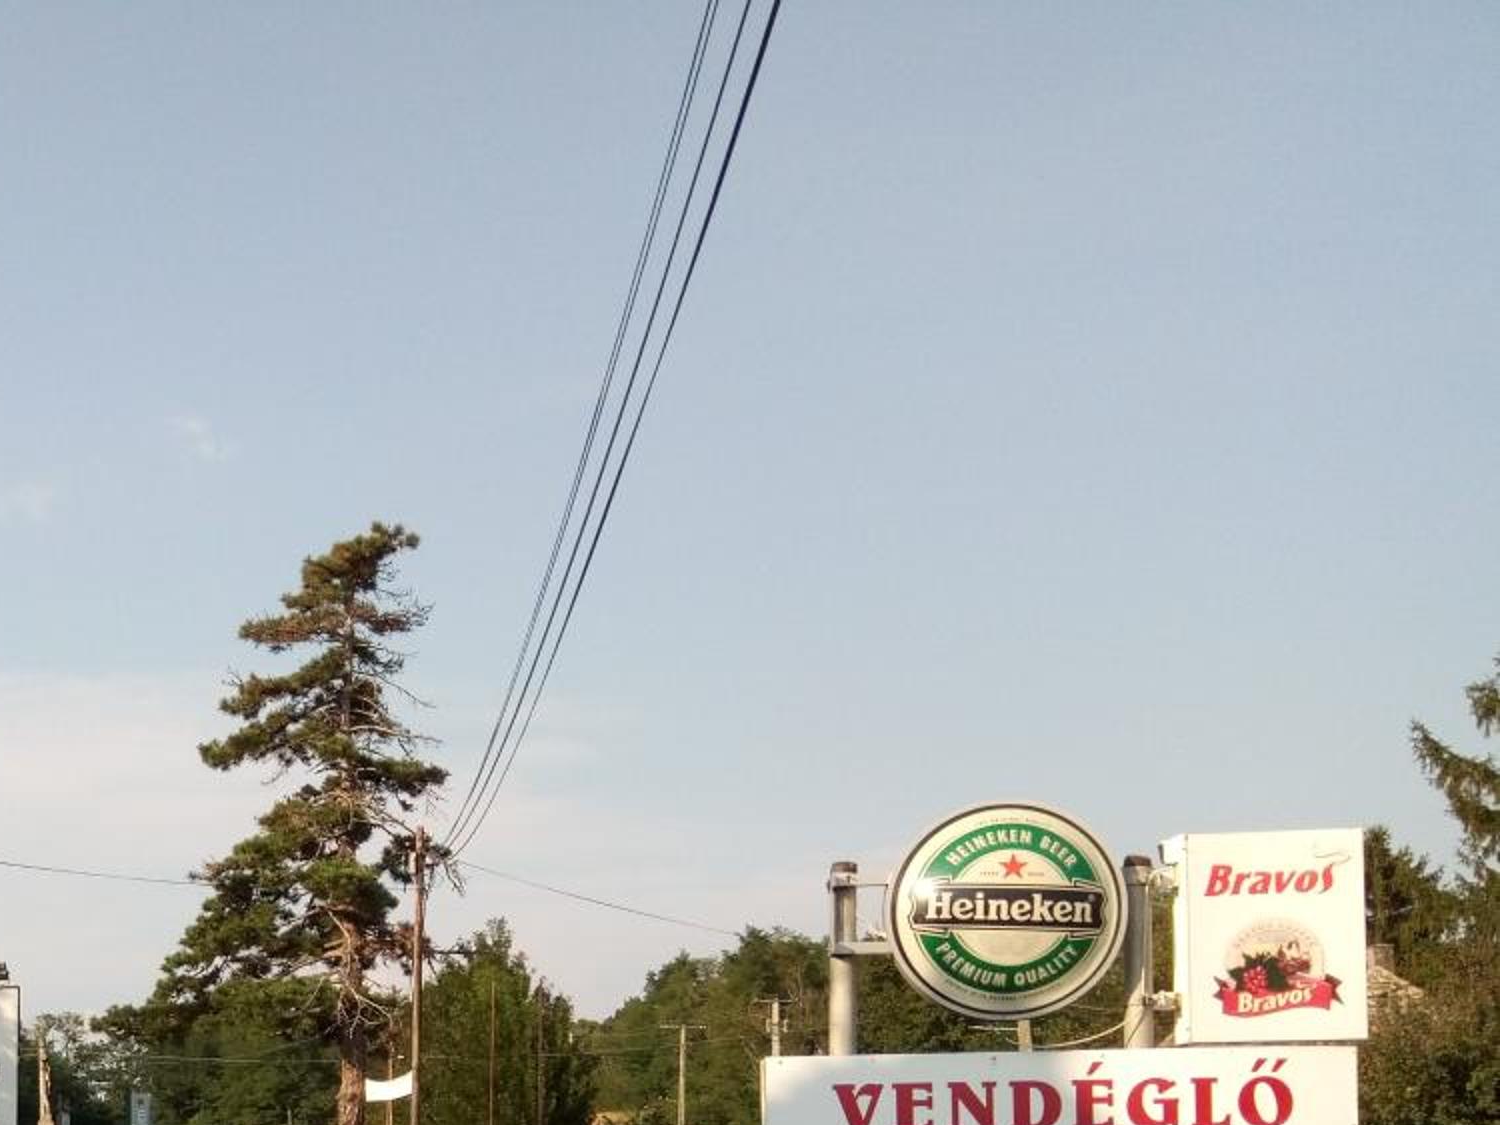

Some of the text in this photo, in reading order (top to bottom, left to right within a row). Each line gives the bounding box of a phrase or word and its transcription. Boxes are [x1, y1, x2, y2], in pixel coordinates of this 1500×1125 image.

[945, 829, 1078, 869] HEINEKEN BEER
[1203, 863, 1334, 896] Bravos
[925, 892, 1093, 923] Heineken
[935, 942, 1078, 987] PREMIUM QUALITY
[1237, 987, 1313, 1014] Bravos
